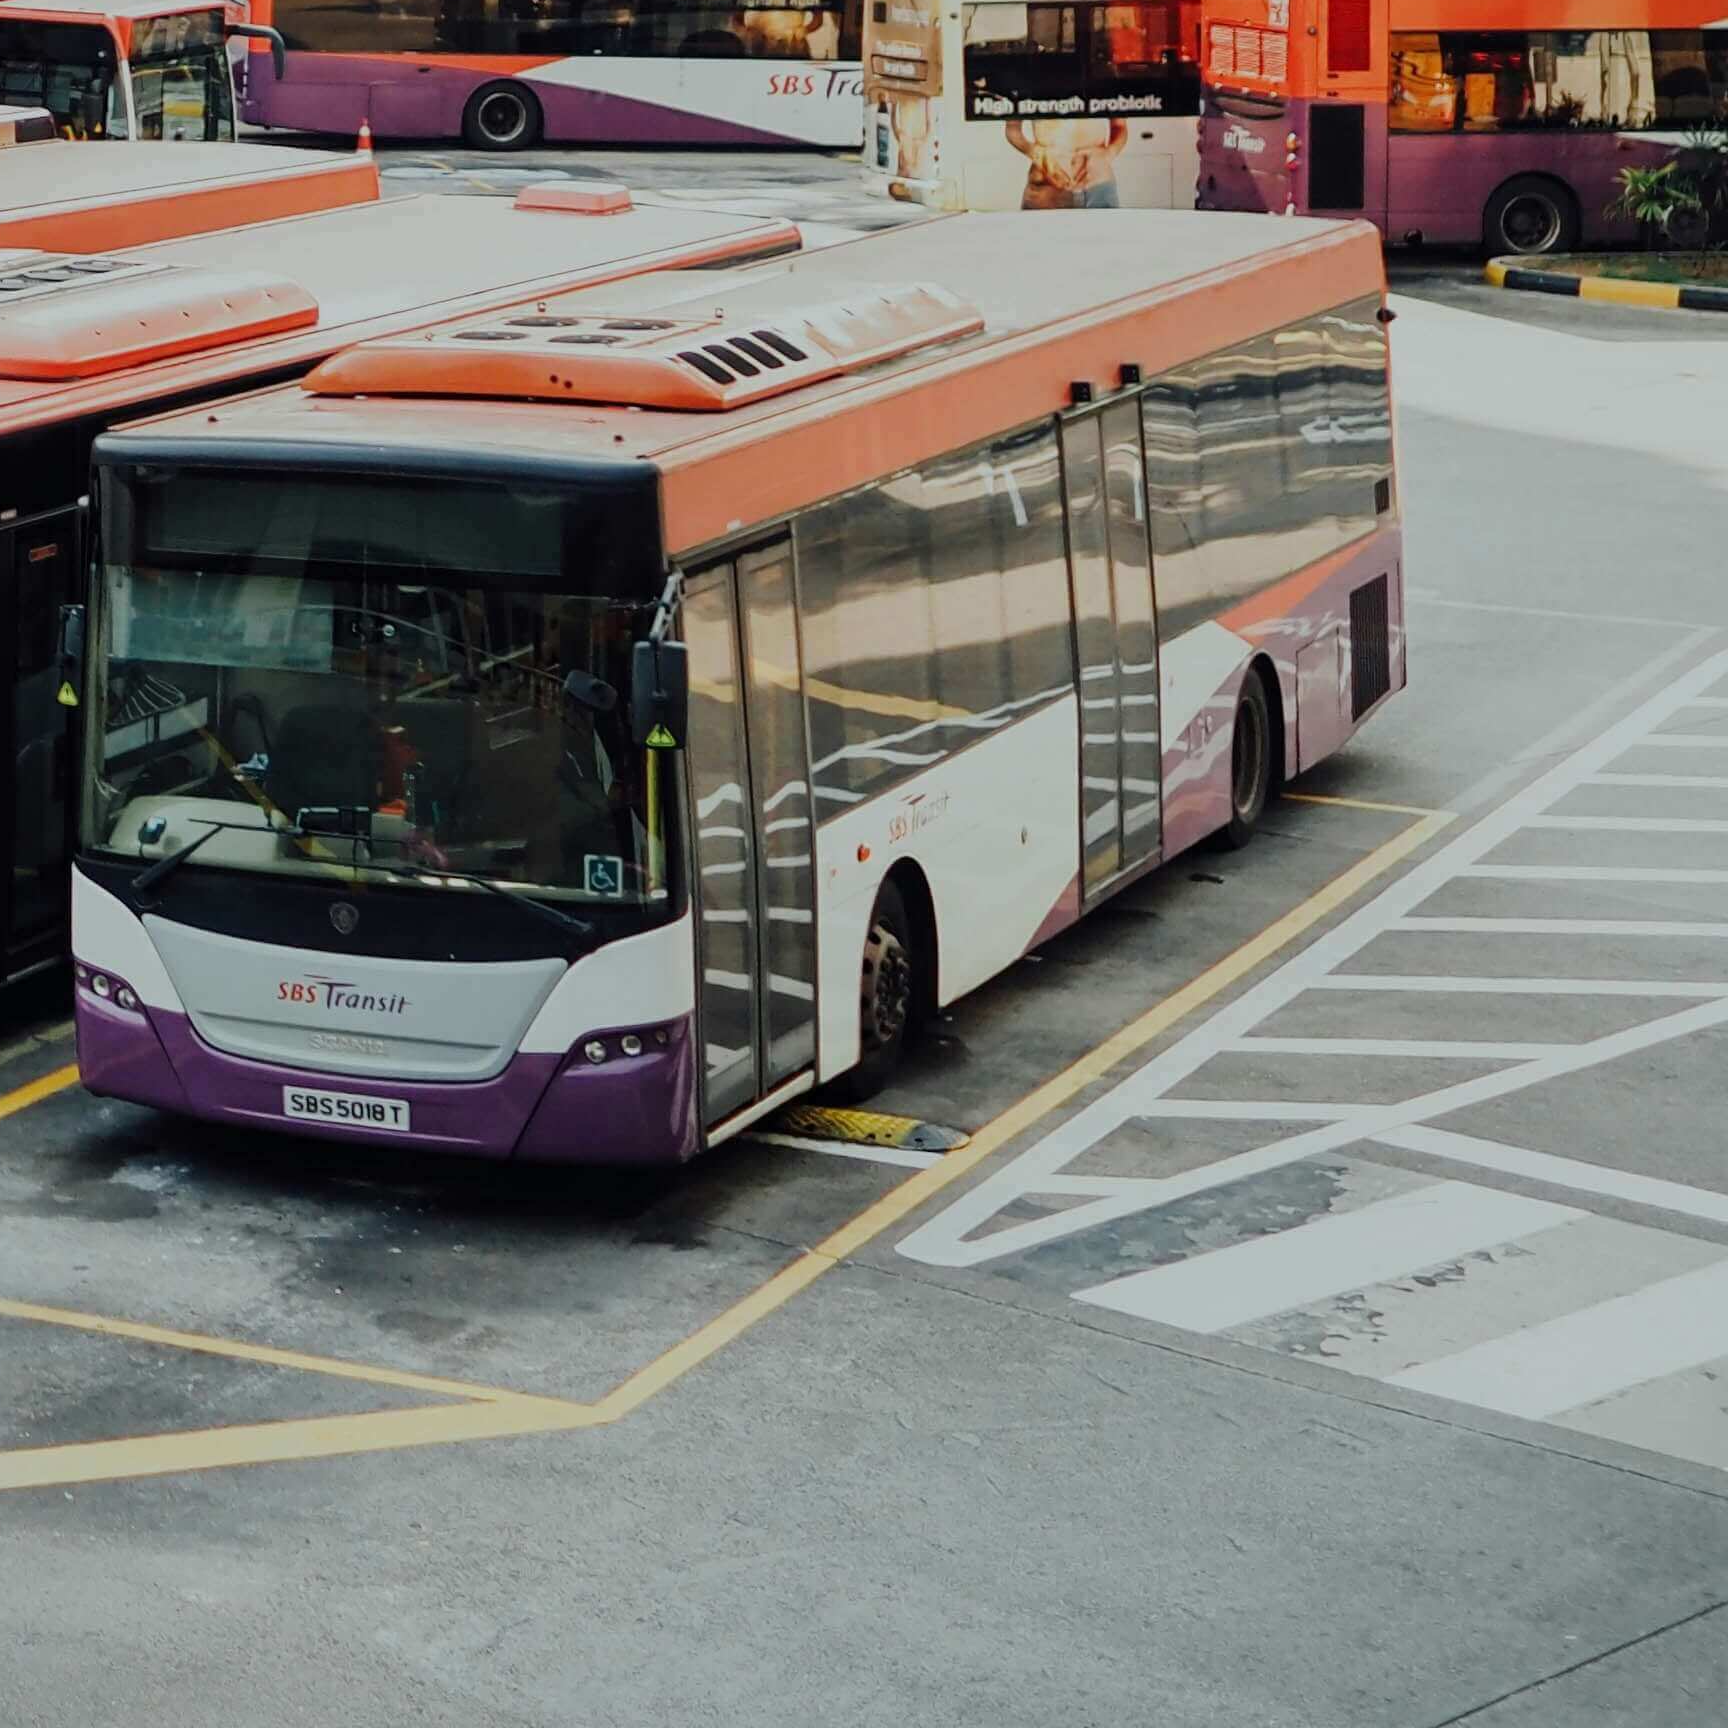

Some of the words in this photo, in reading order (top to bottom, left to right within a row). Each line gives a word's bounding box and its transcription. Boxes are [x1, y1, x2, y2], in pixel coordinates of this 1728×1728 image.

[767, 74, 816, 96] SBS
[974, 98, 1014, 115] High
[1018, 97, 1084, 114] strength
[1089, 95, 1162, 114] probiotic
[277, 981, 317, 1004] SBS
[314, 982, 414, 1015] Transit
[290, 1093, 403, 1124] SBS5018T
